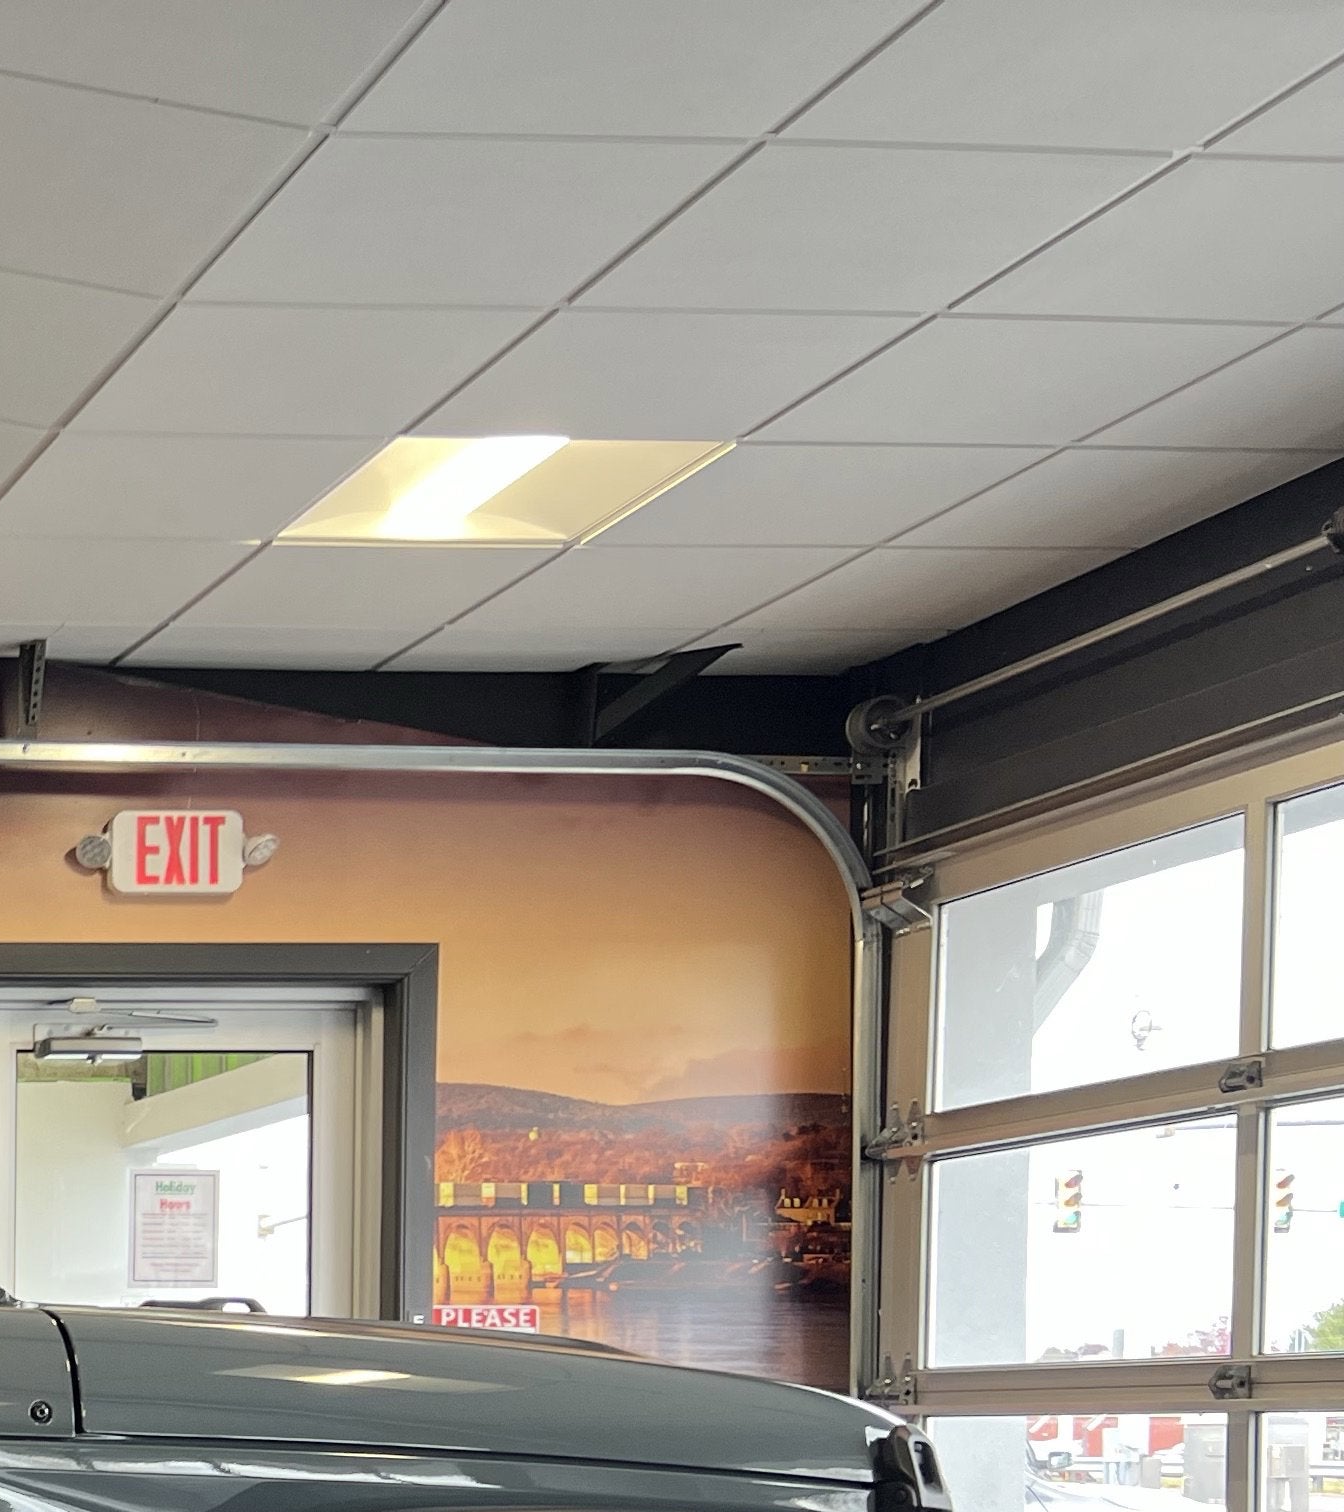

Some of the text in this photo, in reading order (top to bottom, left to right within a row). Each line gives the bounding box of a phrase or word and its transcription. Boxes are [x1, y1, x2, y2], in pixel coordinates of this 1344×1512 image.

[135, 815, 226, 885] EXIT
[155, 1180, 196, 1195] Holiday
[440, 1308, 532, 1328] PLEASE
